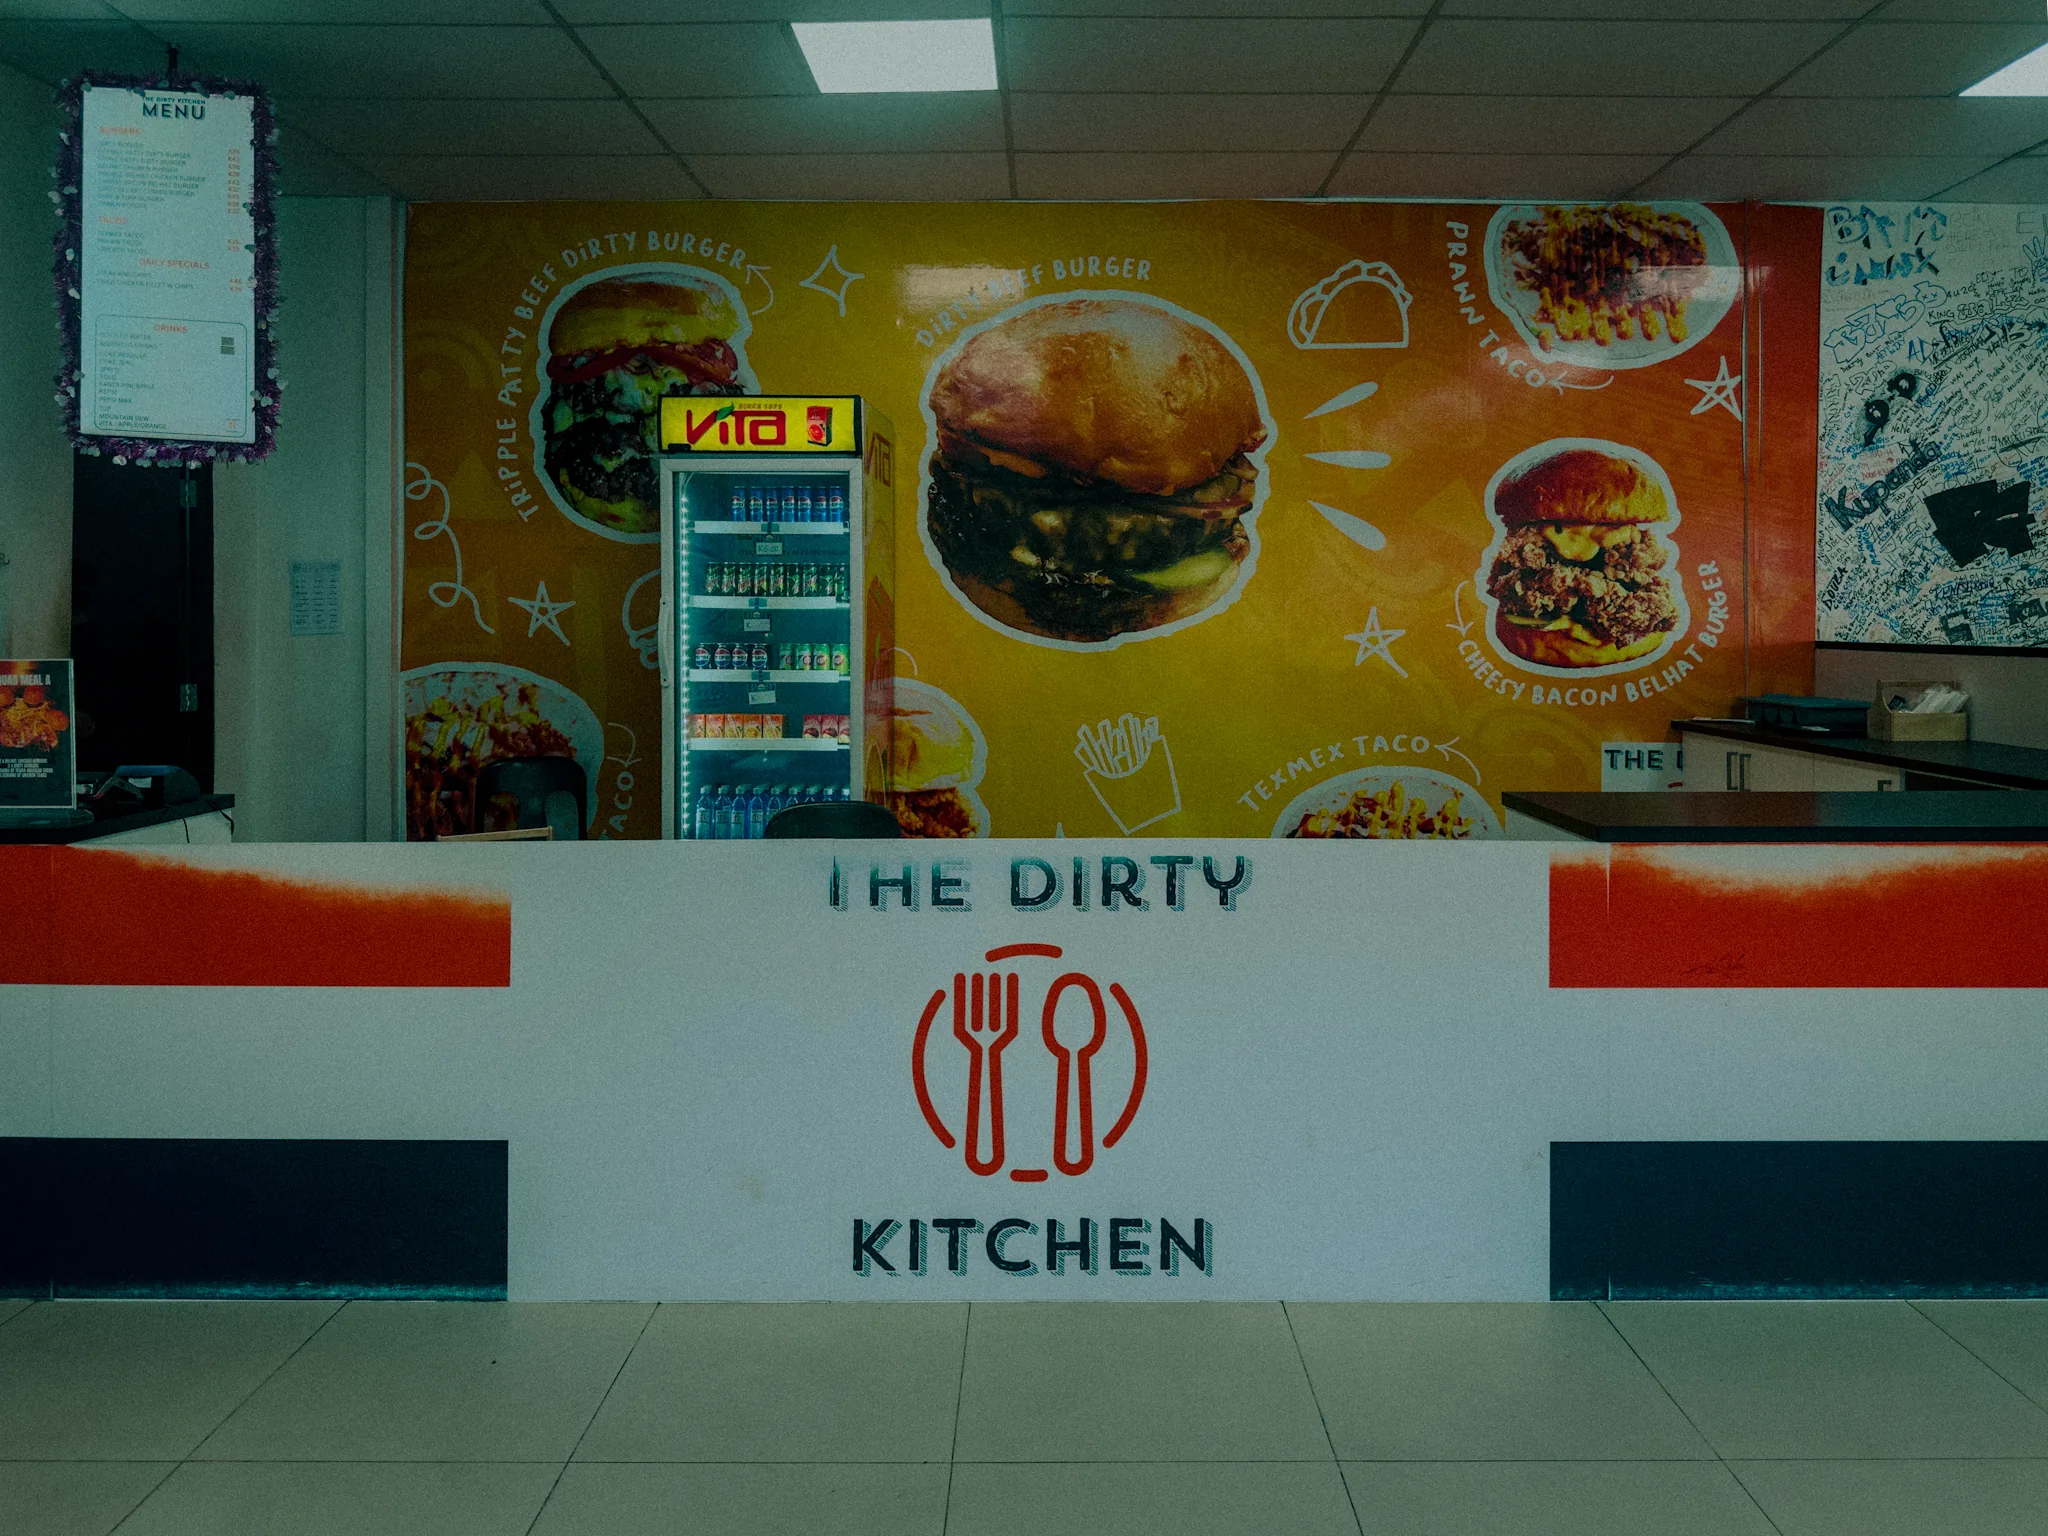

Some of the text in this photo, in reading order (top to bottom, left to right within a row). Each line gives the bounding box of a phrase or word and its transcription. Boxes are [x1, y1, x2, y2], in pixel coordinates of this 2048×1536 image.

[142, 102, 206, 120] MENU
[167, 259, 210, 269] SPECIALS
[513, 263, 558, 320] BEEF
[647, 230, 746, 270] BURGER
[1052, 255, 1152, 281] BURGER
[1446, 221, 1546, 388] PRAWN TACO
[153, 324, 188, 333] DRINKS
[99, 413, 133, 421] MOUNTAIN
[1458, 639, 1526, 701] CHEESY
[1531, 684, 1617, 706] BACON
[1697, 560, 1729, 649] BURGER
[0, 673, 51, 686] UAD MEAL A
[1237, 734, 1430, 812] TEXMEX TACO
[1604, 749, 1664, 771] THE
[600, 770, 634, 840] ACO
[1010, 855, 1253, 912] DIRTY
[852, 1217, 1214, 1278] KITCHEN
